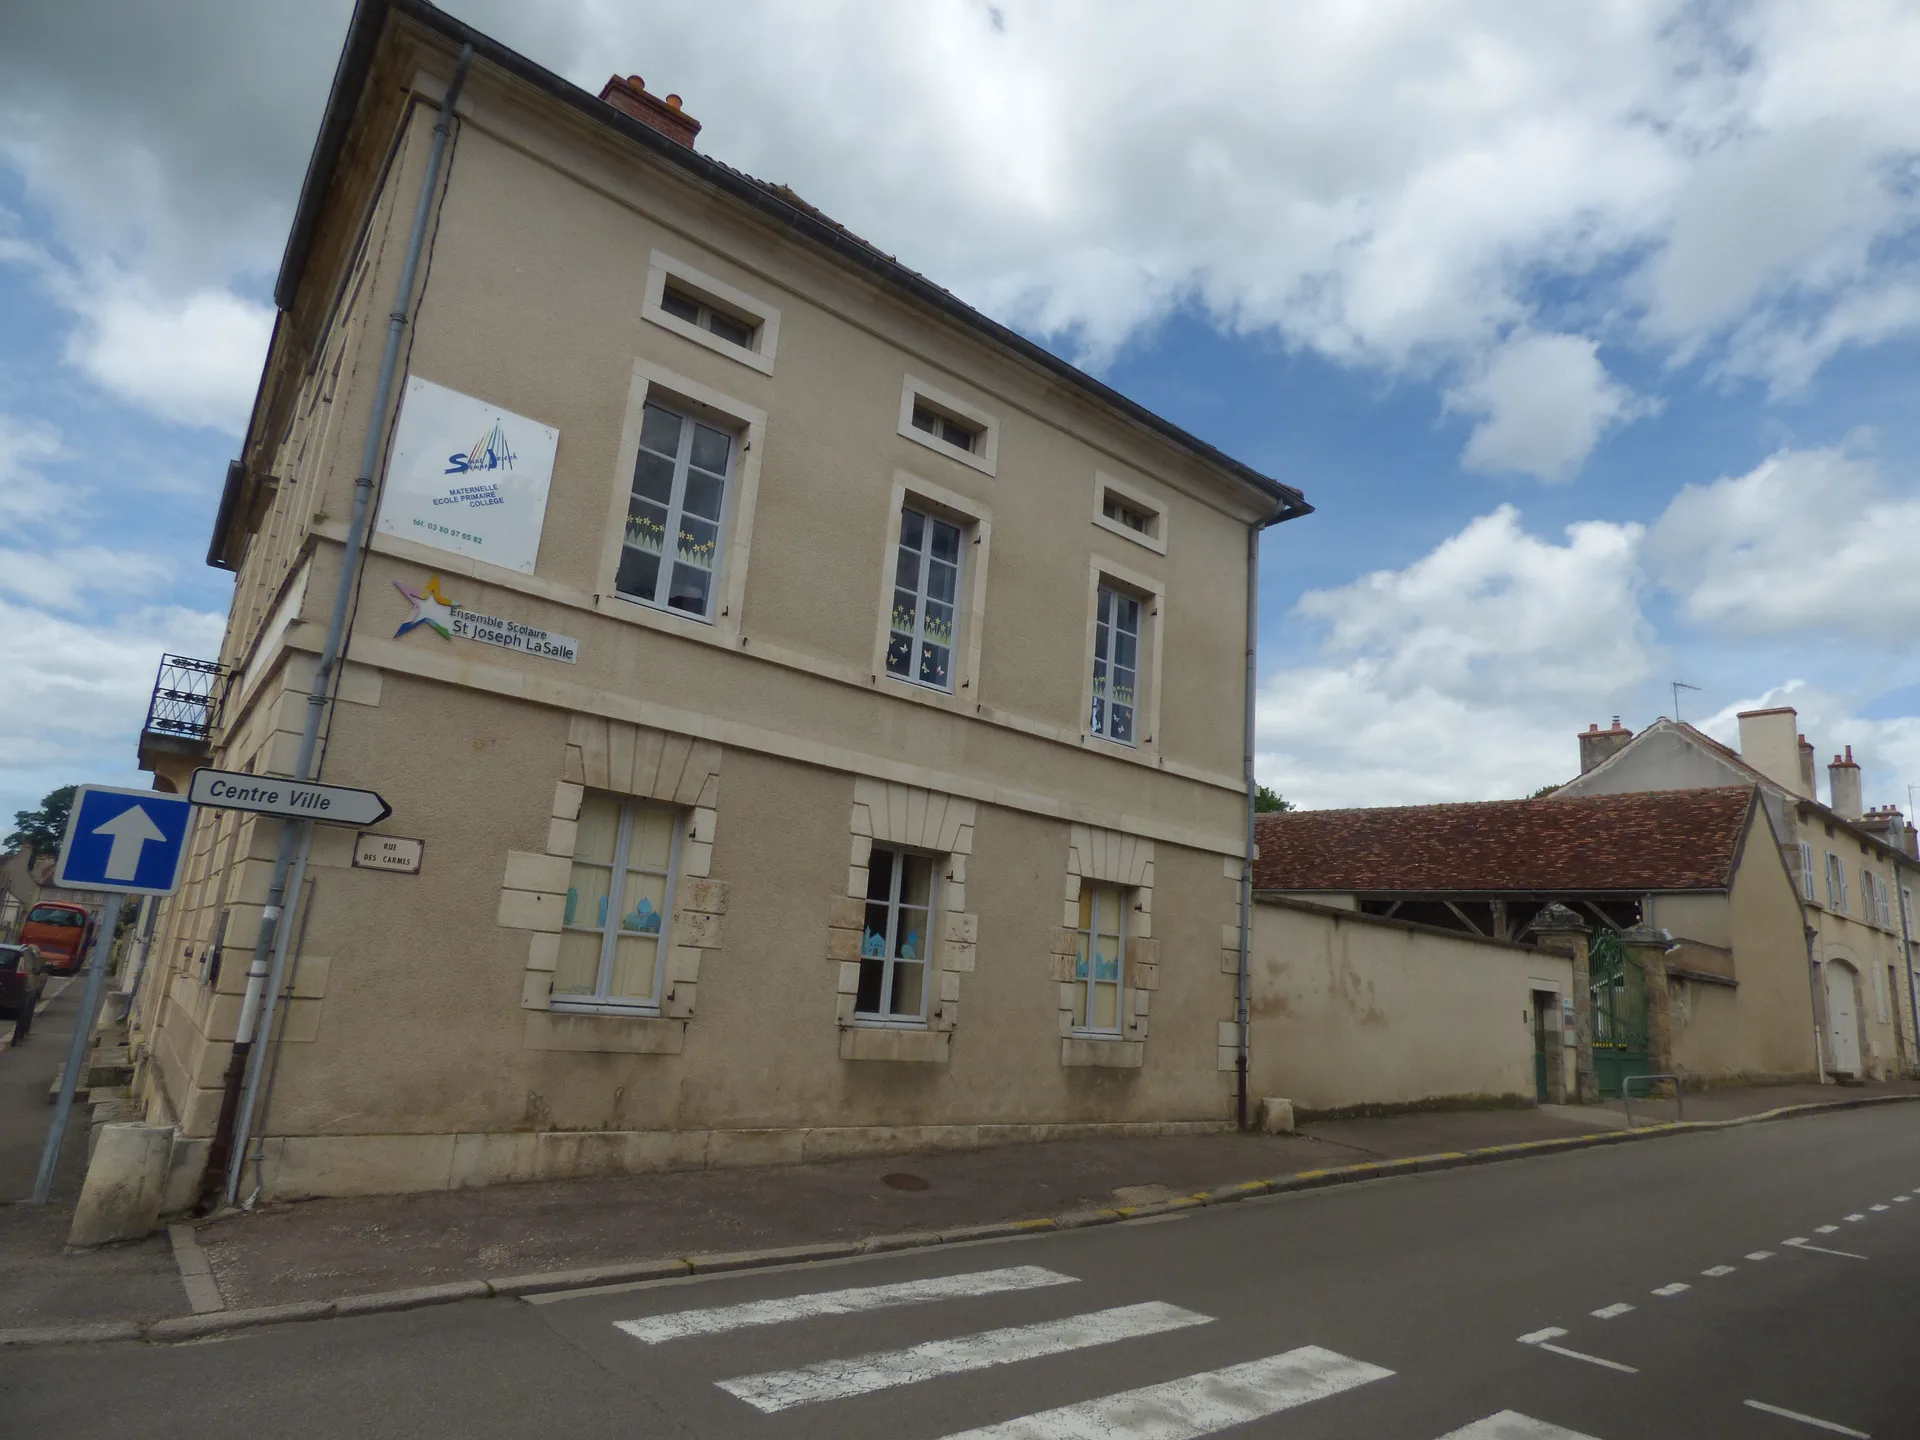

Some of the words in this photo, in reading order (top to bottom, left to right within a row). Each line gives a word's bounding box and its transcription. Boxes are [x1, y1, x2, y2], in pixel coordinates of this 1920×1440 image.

[449, 484, 499, 497] MATERNELLE
[433, 496, 460, 506] ECOLE
[460, 491, 497, 502] PRIMAIRE
[469, 497, 505, 508] COLLEGE
[427, 522, 438, 532] 03
[439, 525, 449, 535] 80
[450, 529, 461, 538] 97
[461, 532, 472, 541] 05
[472, 536, 483, 545] 82
[449, 606, 504, 629] Ensemble
[506, 621, 548, 640] Scolaire
[452, 619, 470, 634] St
[471, 624, 522, 647] Joseph
[210, 780, 279, 804] Centre
[289, 790, 331, 810] Ville
[383, 843, 397, 851] RUE
[364, 853, 377, 862] DES
[382, 855, 411, 865] CARMES
